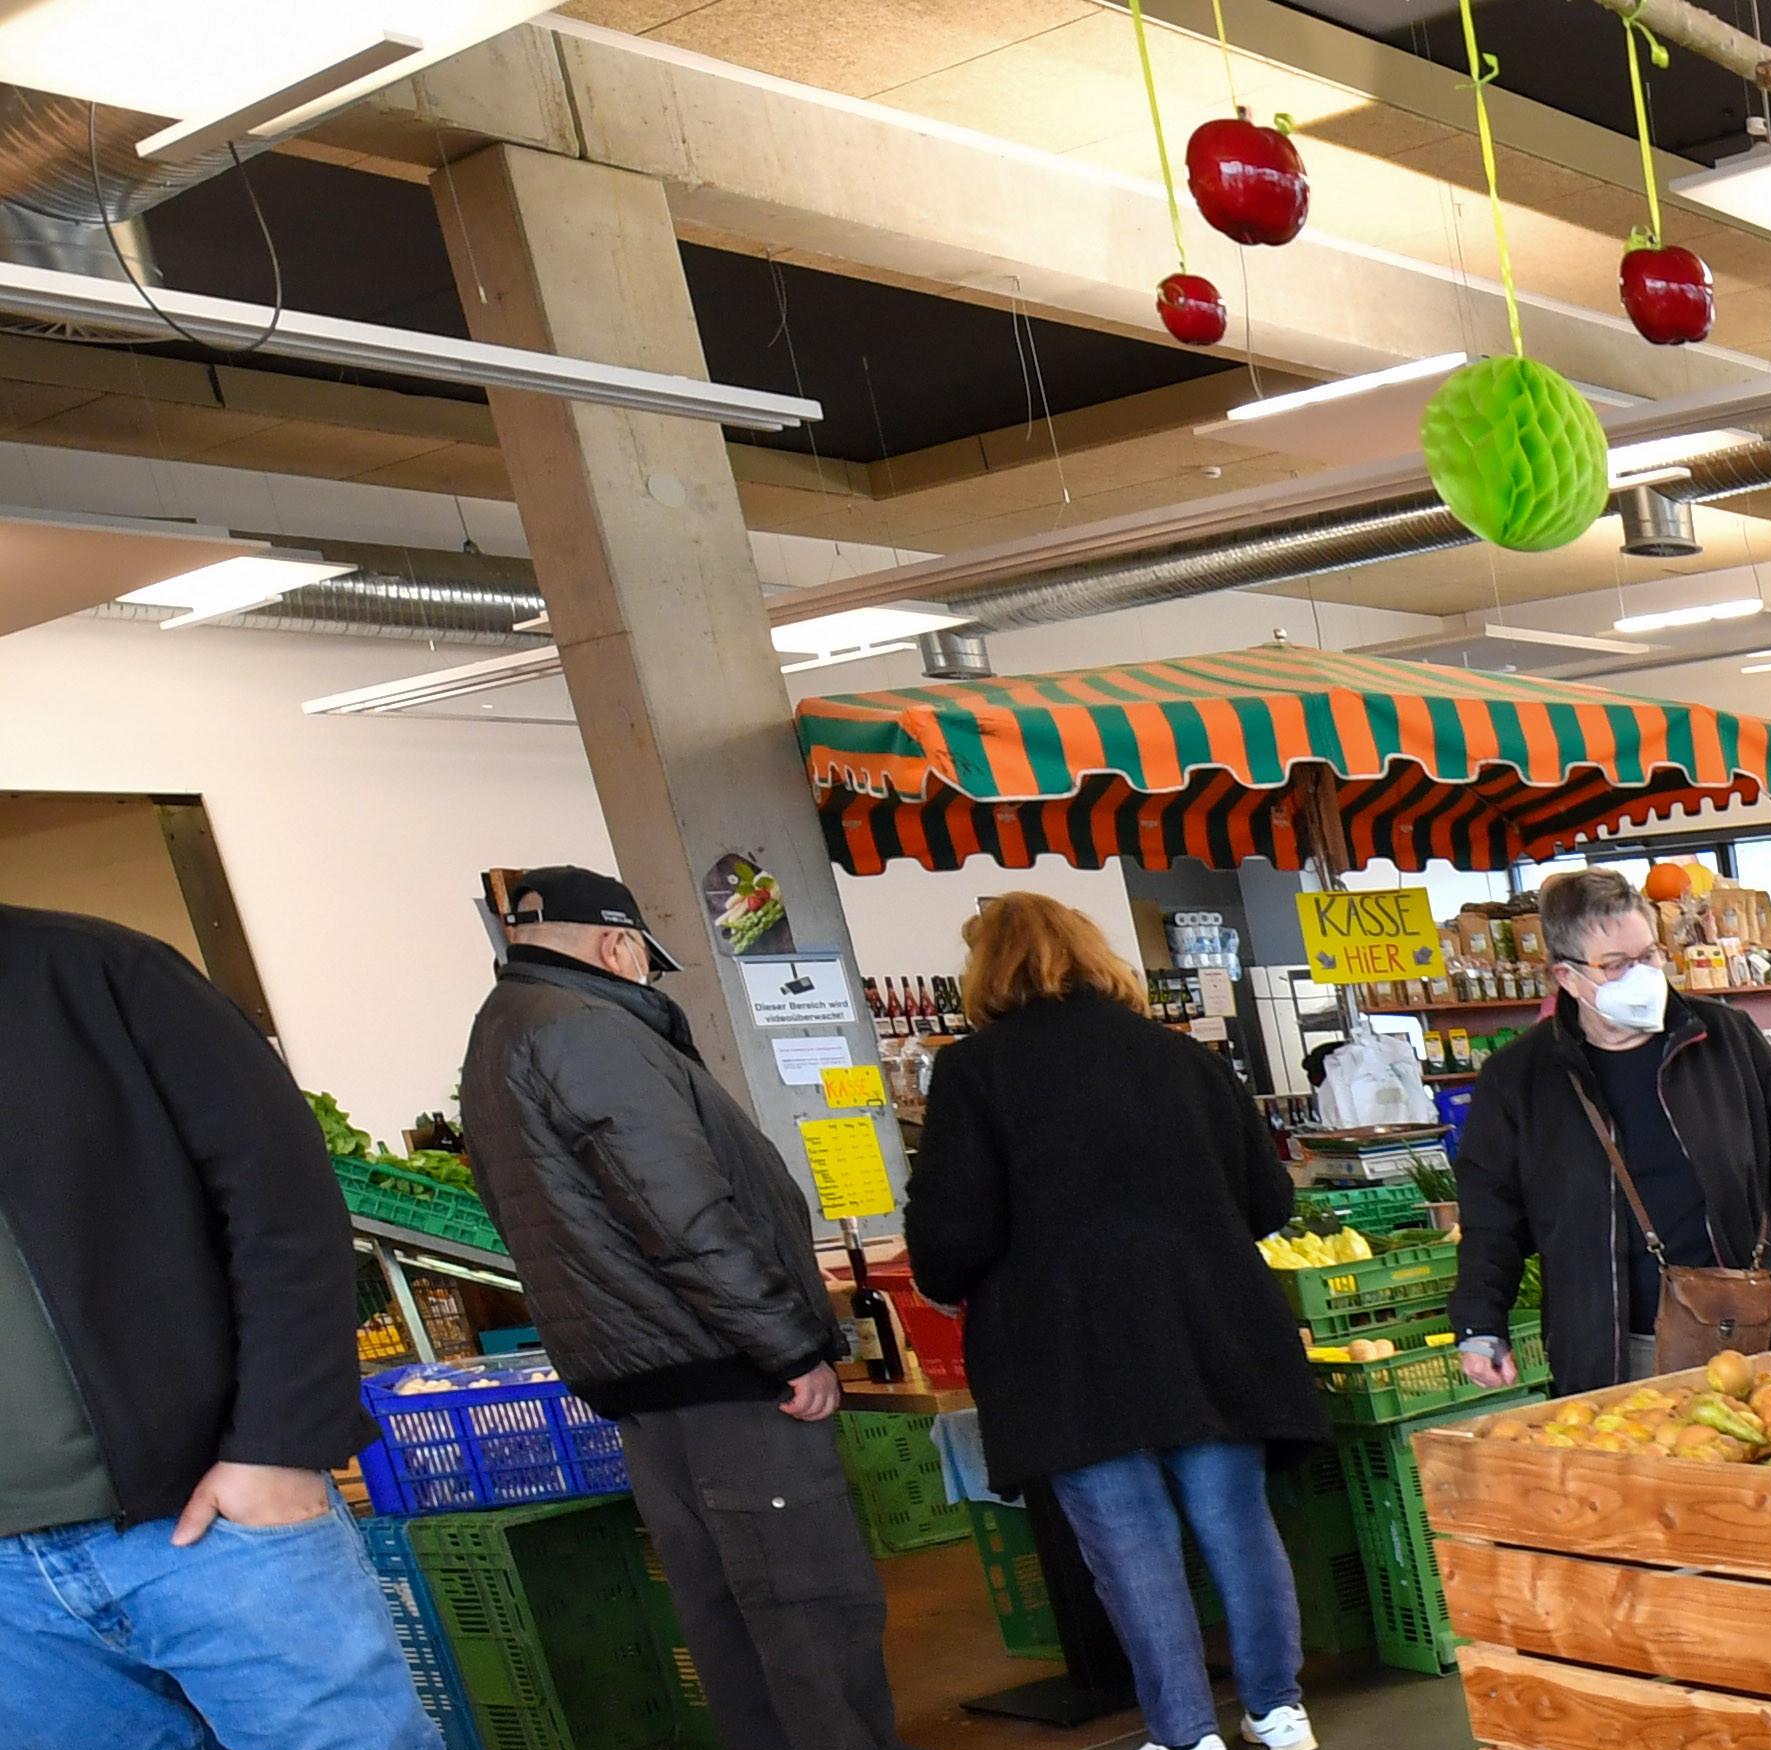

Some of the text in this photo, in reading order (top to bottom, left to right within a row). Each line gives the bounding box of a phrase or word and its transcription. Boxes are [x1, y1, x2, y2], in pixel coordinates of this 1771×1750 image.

[1313, 894, 1420, 937] KASSE
[754, 999, 849, 1012] Dieser Bereich wird
